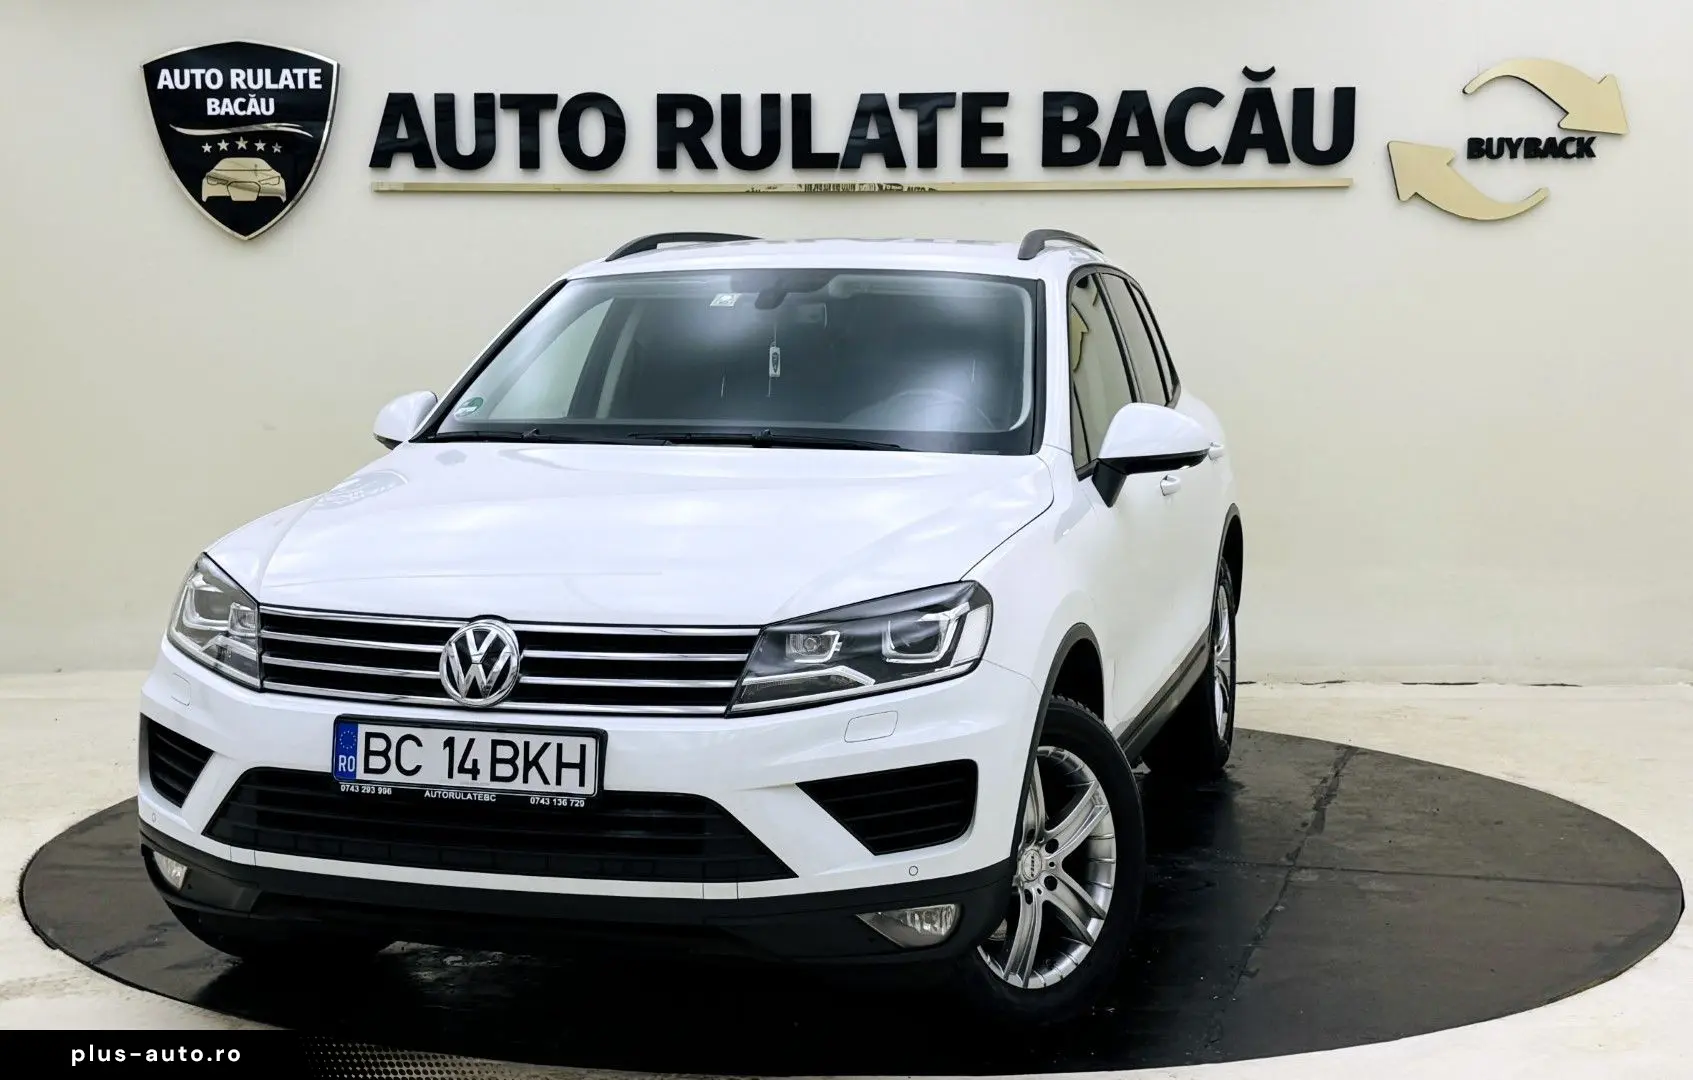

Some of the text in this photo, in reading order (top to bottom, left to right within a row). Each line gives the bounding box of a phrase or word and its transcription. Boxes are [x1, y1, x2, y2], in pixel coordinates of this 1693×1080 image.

[157, 68, 322, 90] AUTO RULATE
[206, 94, 275, 116] BACĂU
[369, 65, 1356, 170] AUTO RULATE BACĂU
[1467, 136, 1597, 159] BUYBACK
[444, 624, 516, 702] VW
[338, 754, 356, 773] RO
[363, 731, 587, 787] BC 14 BKH
[340, 784, 360, 793] 0743
[361, 786, 376, 794] 293
[424, 790, 497, 802] AUTORULATEBC
[529, 796, 550, 806] 0743
[552, 798, 568, 806] 136
